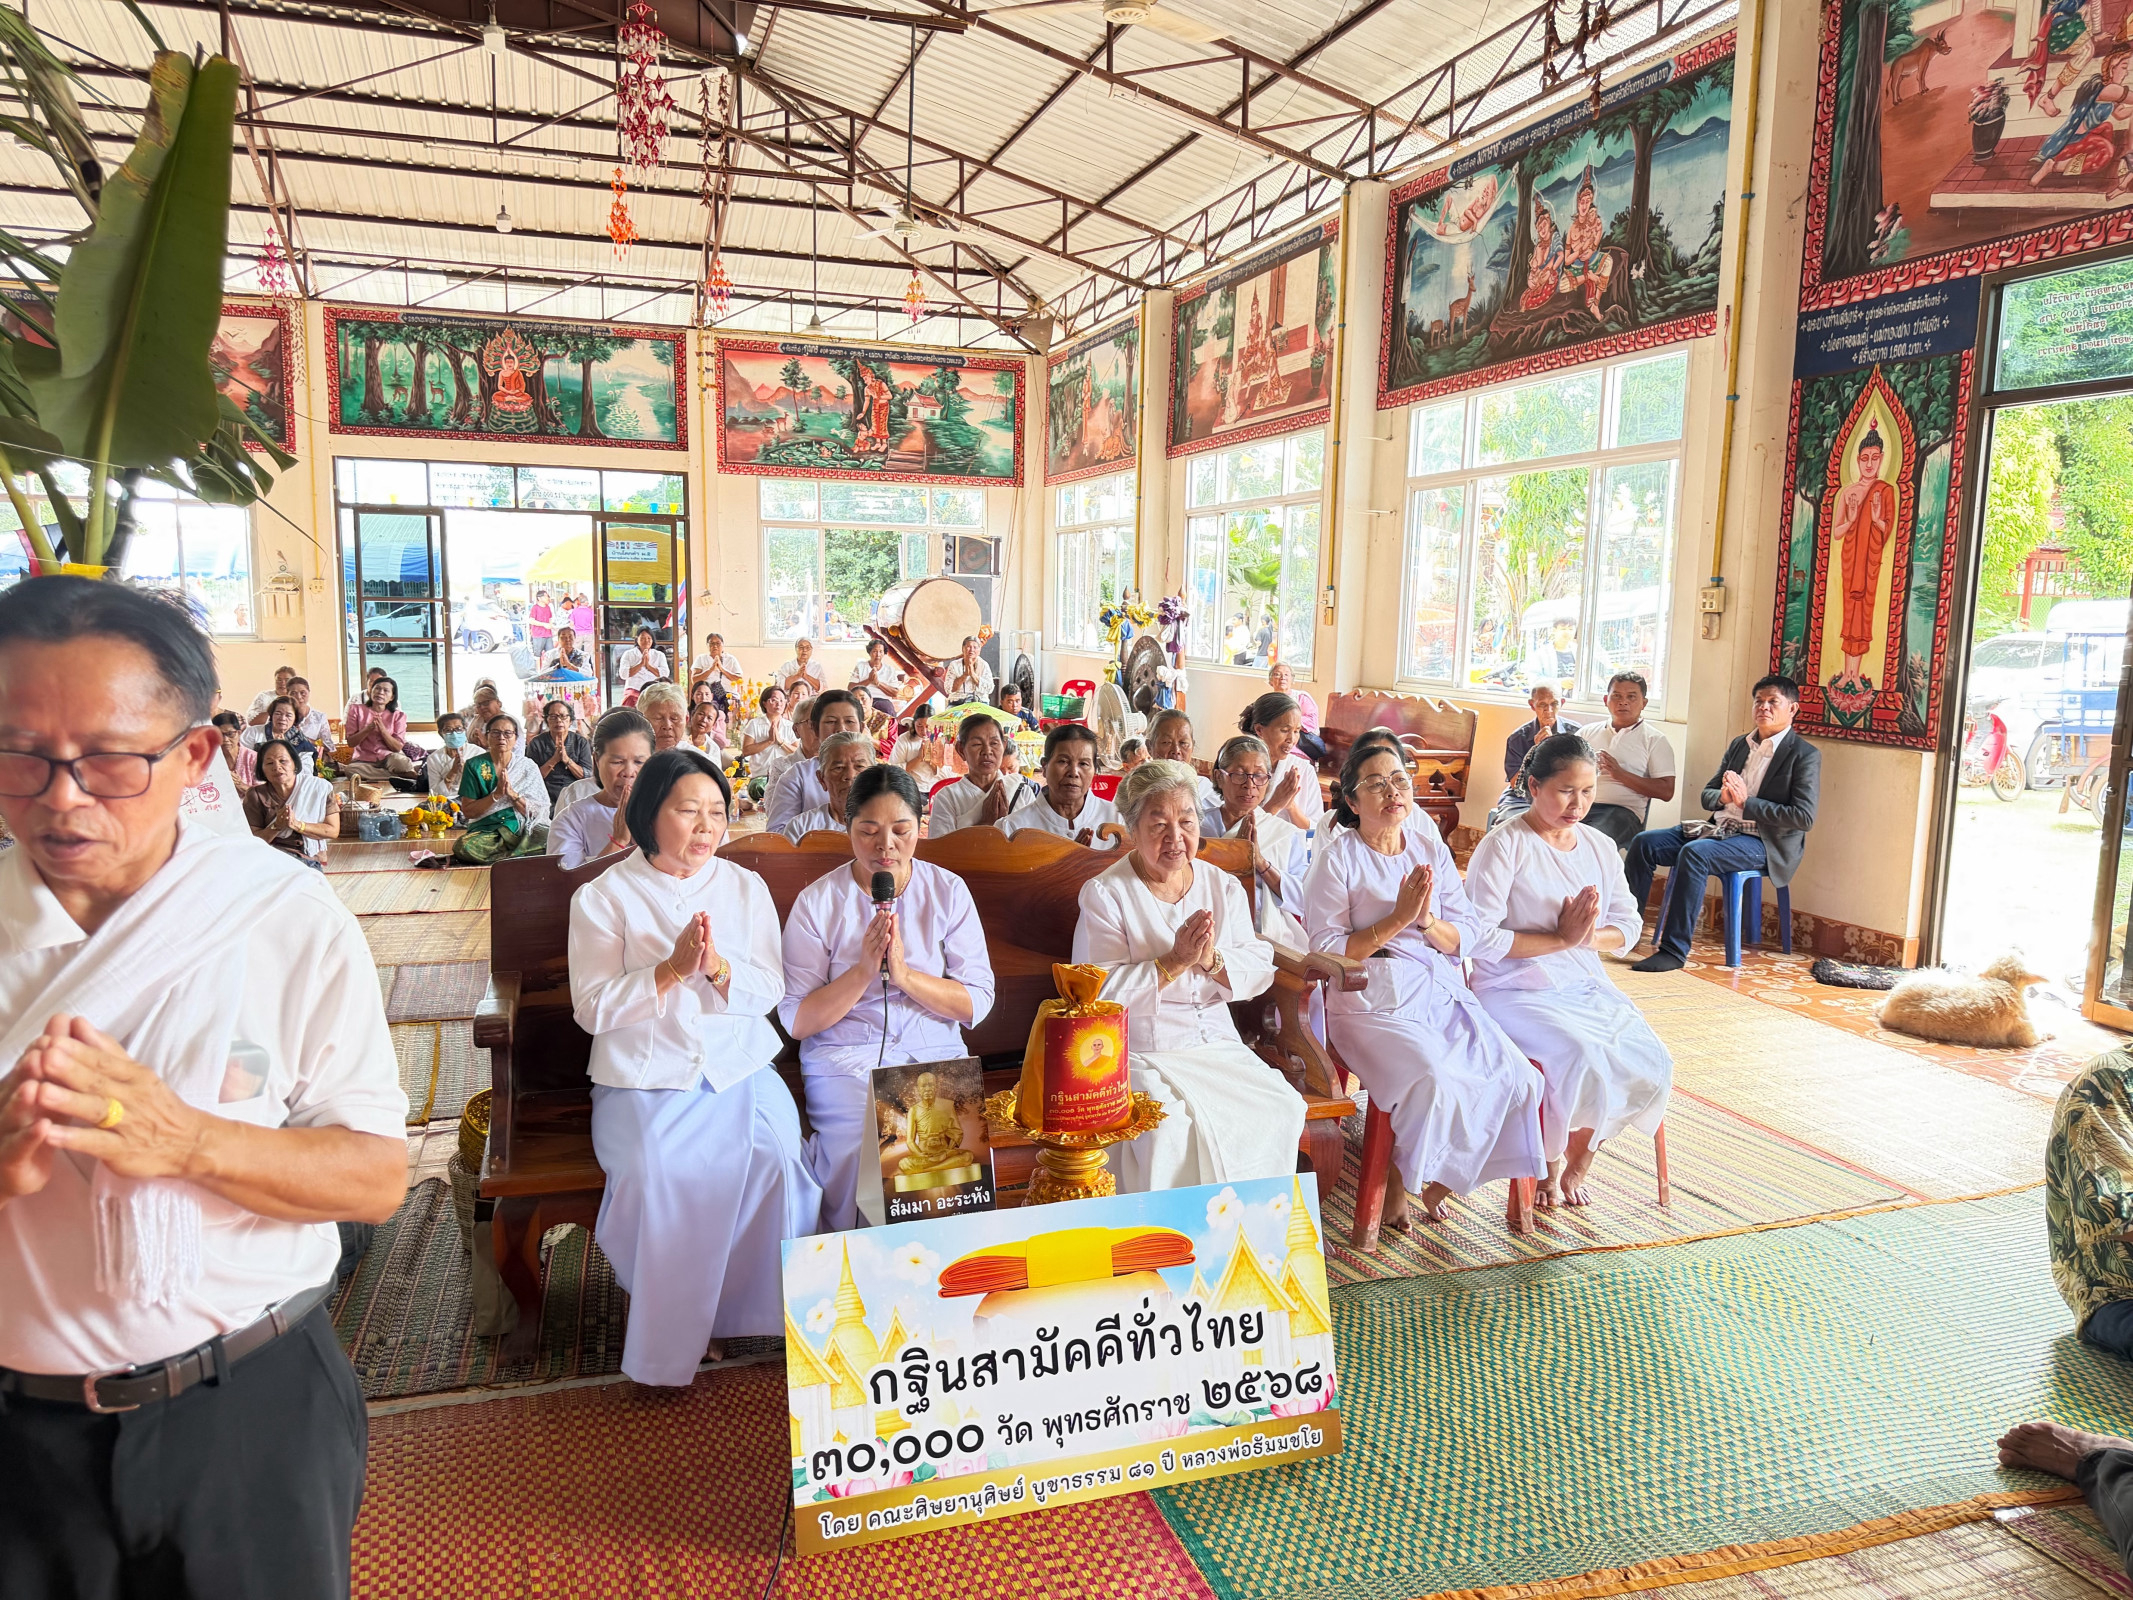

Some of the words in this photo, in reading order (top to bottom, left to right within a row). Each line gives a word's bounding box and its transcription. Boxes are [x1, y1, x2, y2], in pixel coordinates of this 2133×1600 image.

[1050, 1080, 1128, 1105] กฐินสามัคคีทั่วไทย
[889, 1197, 931, 1217] สัมมา
[936, 1186, 991, 1210] อะระหัง
[870, 1297, 1264, 1416] กฐินสามัคคีทั่วไทย
[812, 1424, 984, 1481] ๓๐,๐๐๐
[997, 1413, 1033, 1446] วัด
[1042, 1393, 1190, 1448] พุทธศักราช
[1201, 1361, 1323, 1409] ๒๕๖๘
[820, 1515, 860, 1537] โดย
[869, 1478, 1025, 1528] คณะศิษยานุศิษย์
[1032, 1467, 1121, 1502] บูชาธรรม
[1129, 1462, 1155, 1479] ๘๑
[1162, 1451, 1175, 1472] ปี
[1182, 1427, 1322, 1468] หลวงพ่อธัมมชโย
